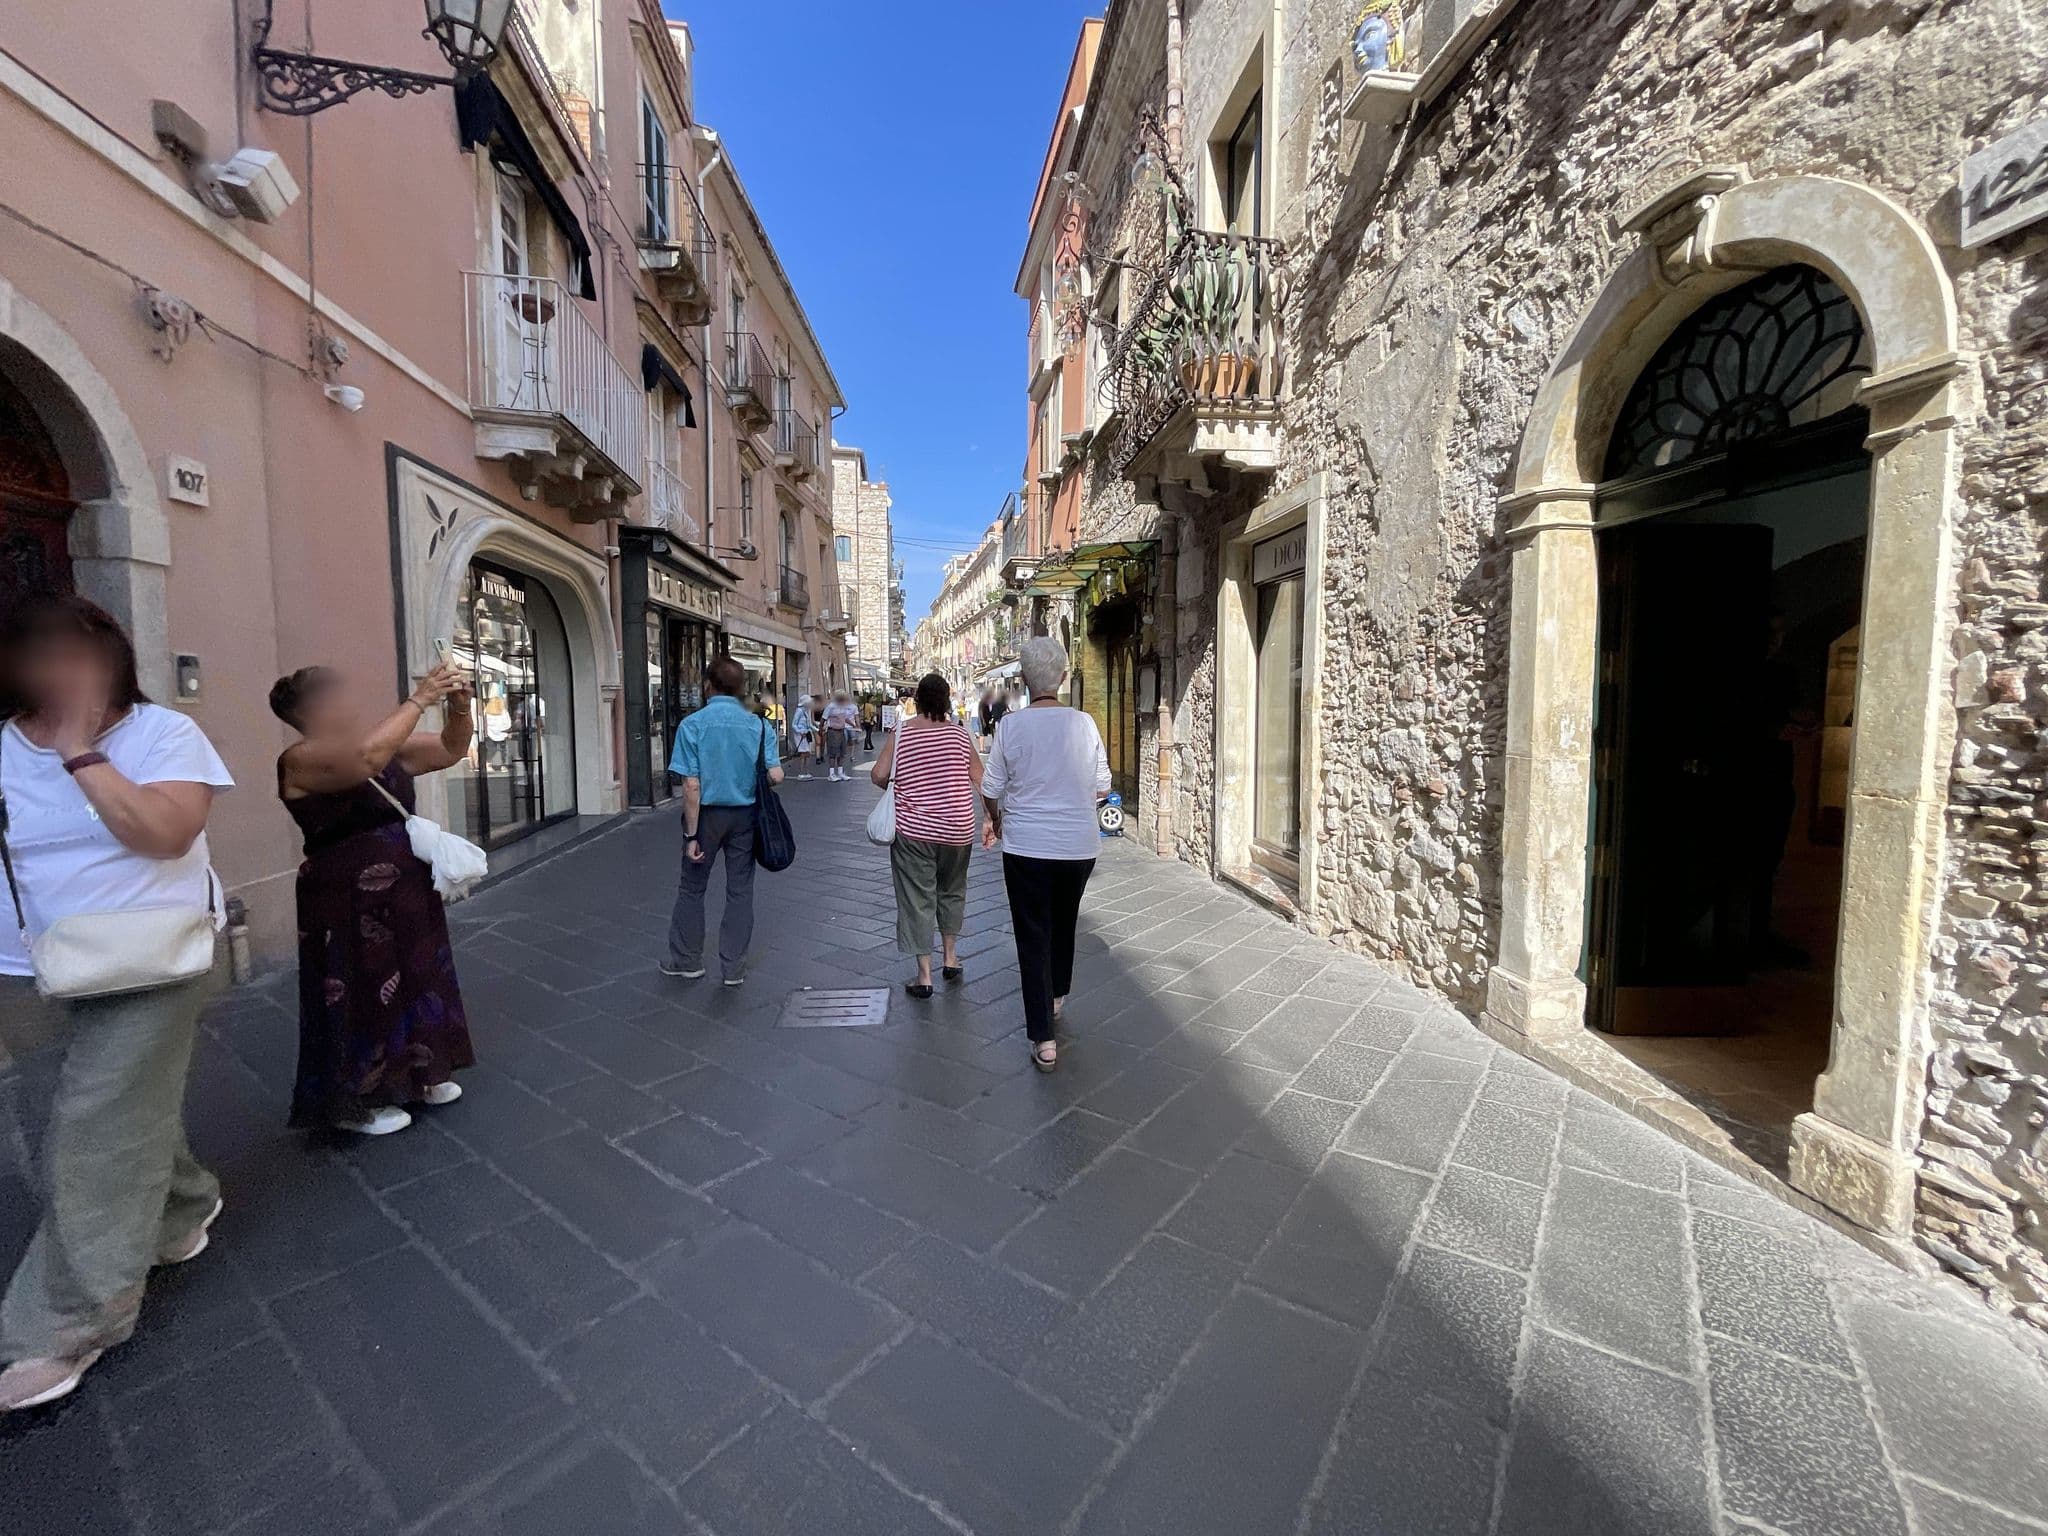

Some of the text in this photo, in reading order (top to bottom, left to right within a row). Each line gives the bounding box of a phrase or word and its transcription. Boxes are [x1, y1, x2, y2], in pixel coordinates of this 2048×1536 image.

[175, 468, 204, 493] 107
[653, 567, 720, 616] DI BLASI
